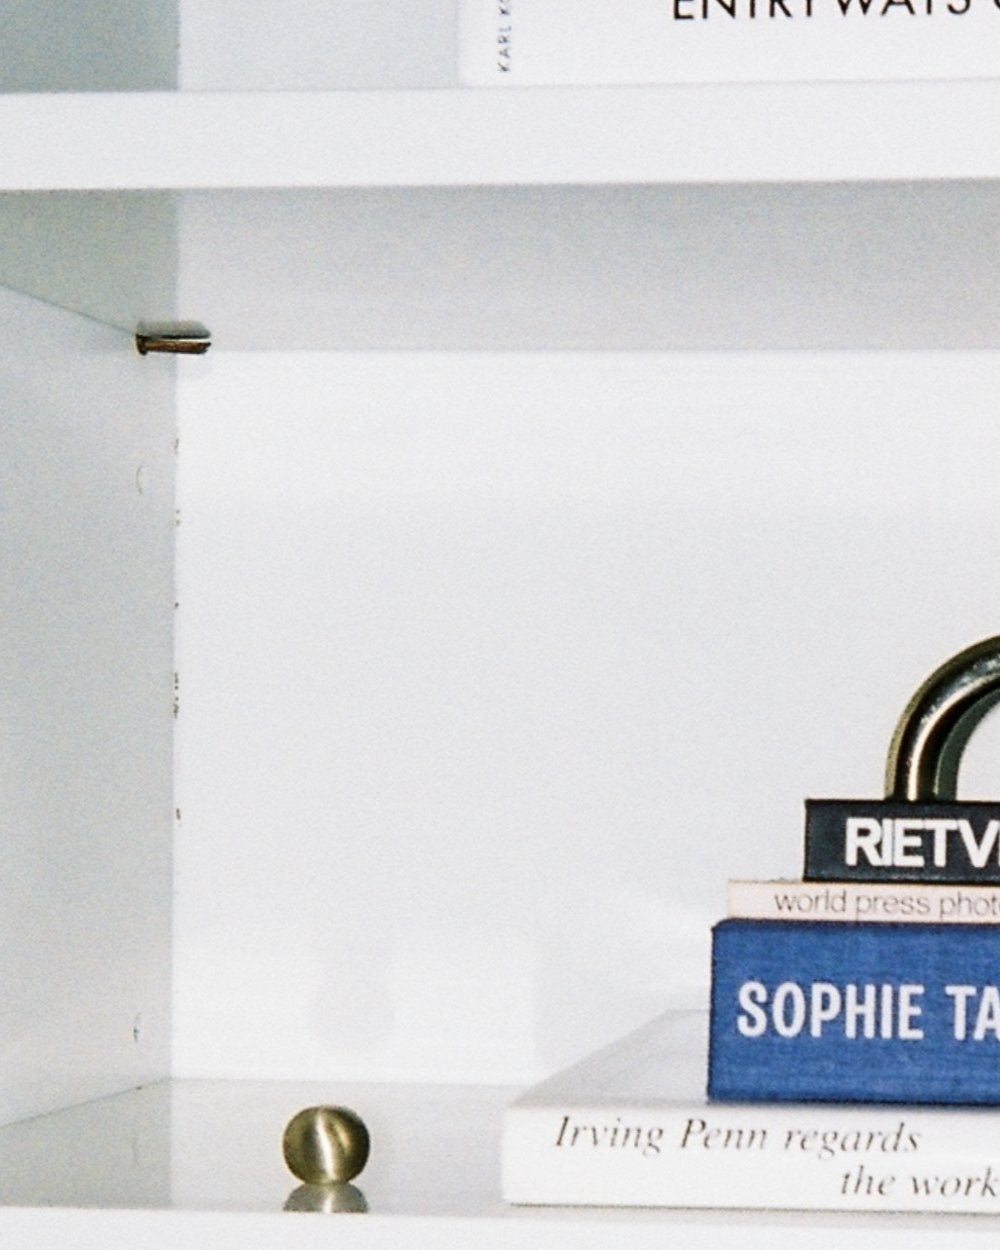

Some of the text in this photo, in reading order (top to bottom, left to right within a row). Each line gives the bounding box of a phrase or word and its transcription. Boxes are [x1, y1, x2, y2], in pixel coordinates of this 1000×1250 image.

[774, 889, 847, 912] world
[855, 893, 931, 920] press
[737, 981, 925, 1040] SOPHIE
[554, 1115, 920, 1156] Irving Penn regards
[841, 1164, 897, 1197] the
[911, 1166, 1000, 1198] work
